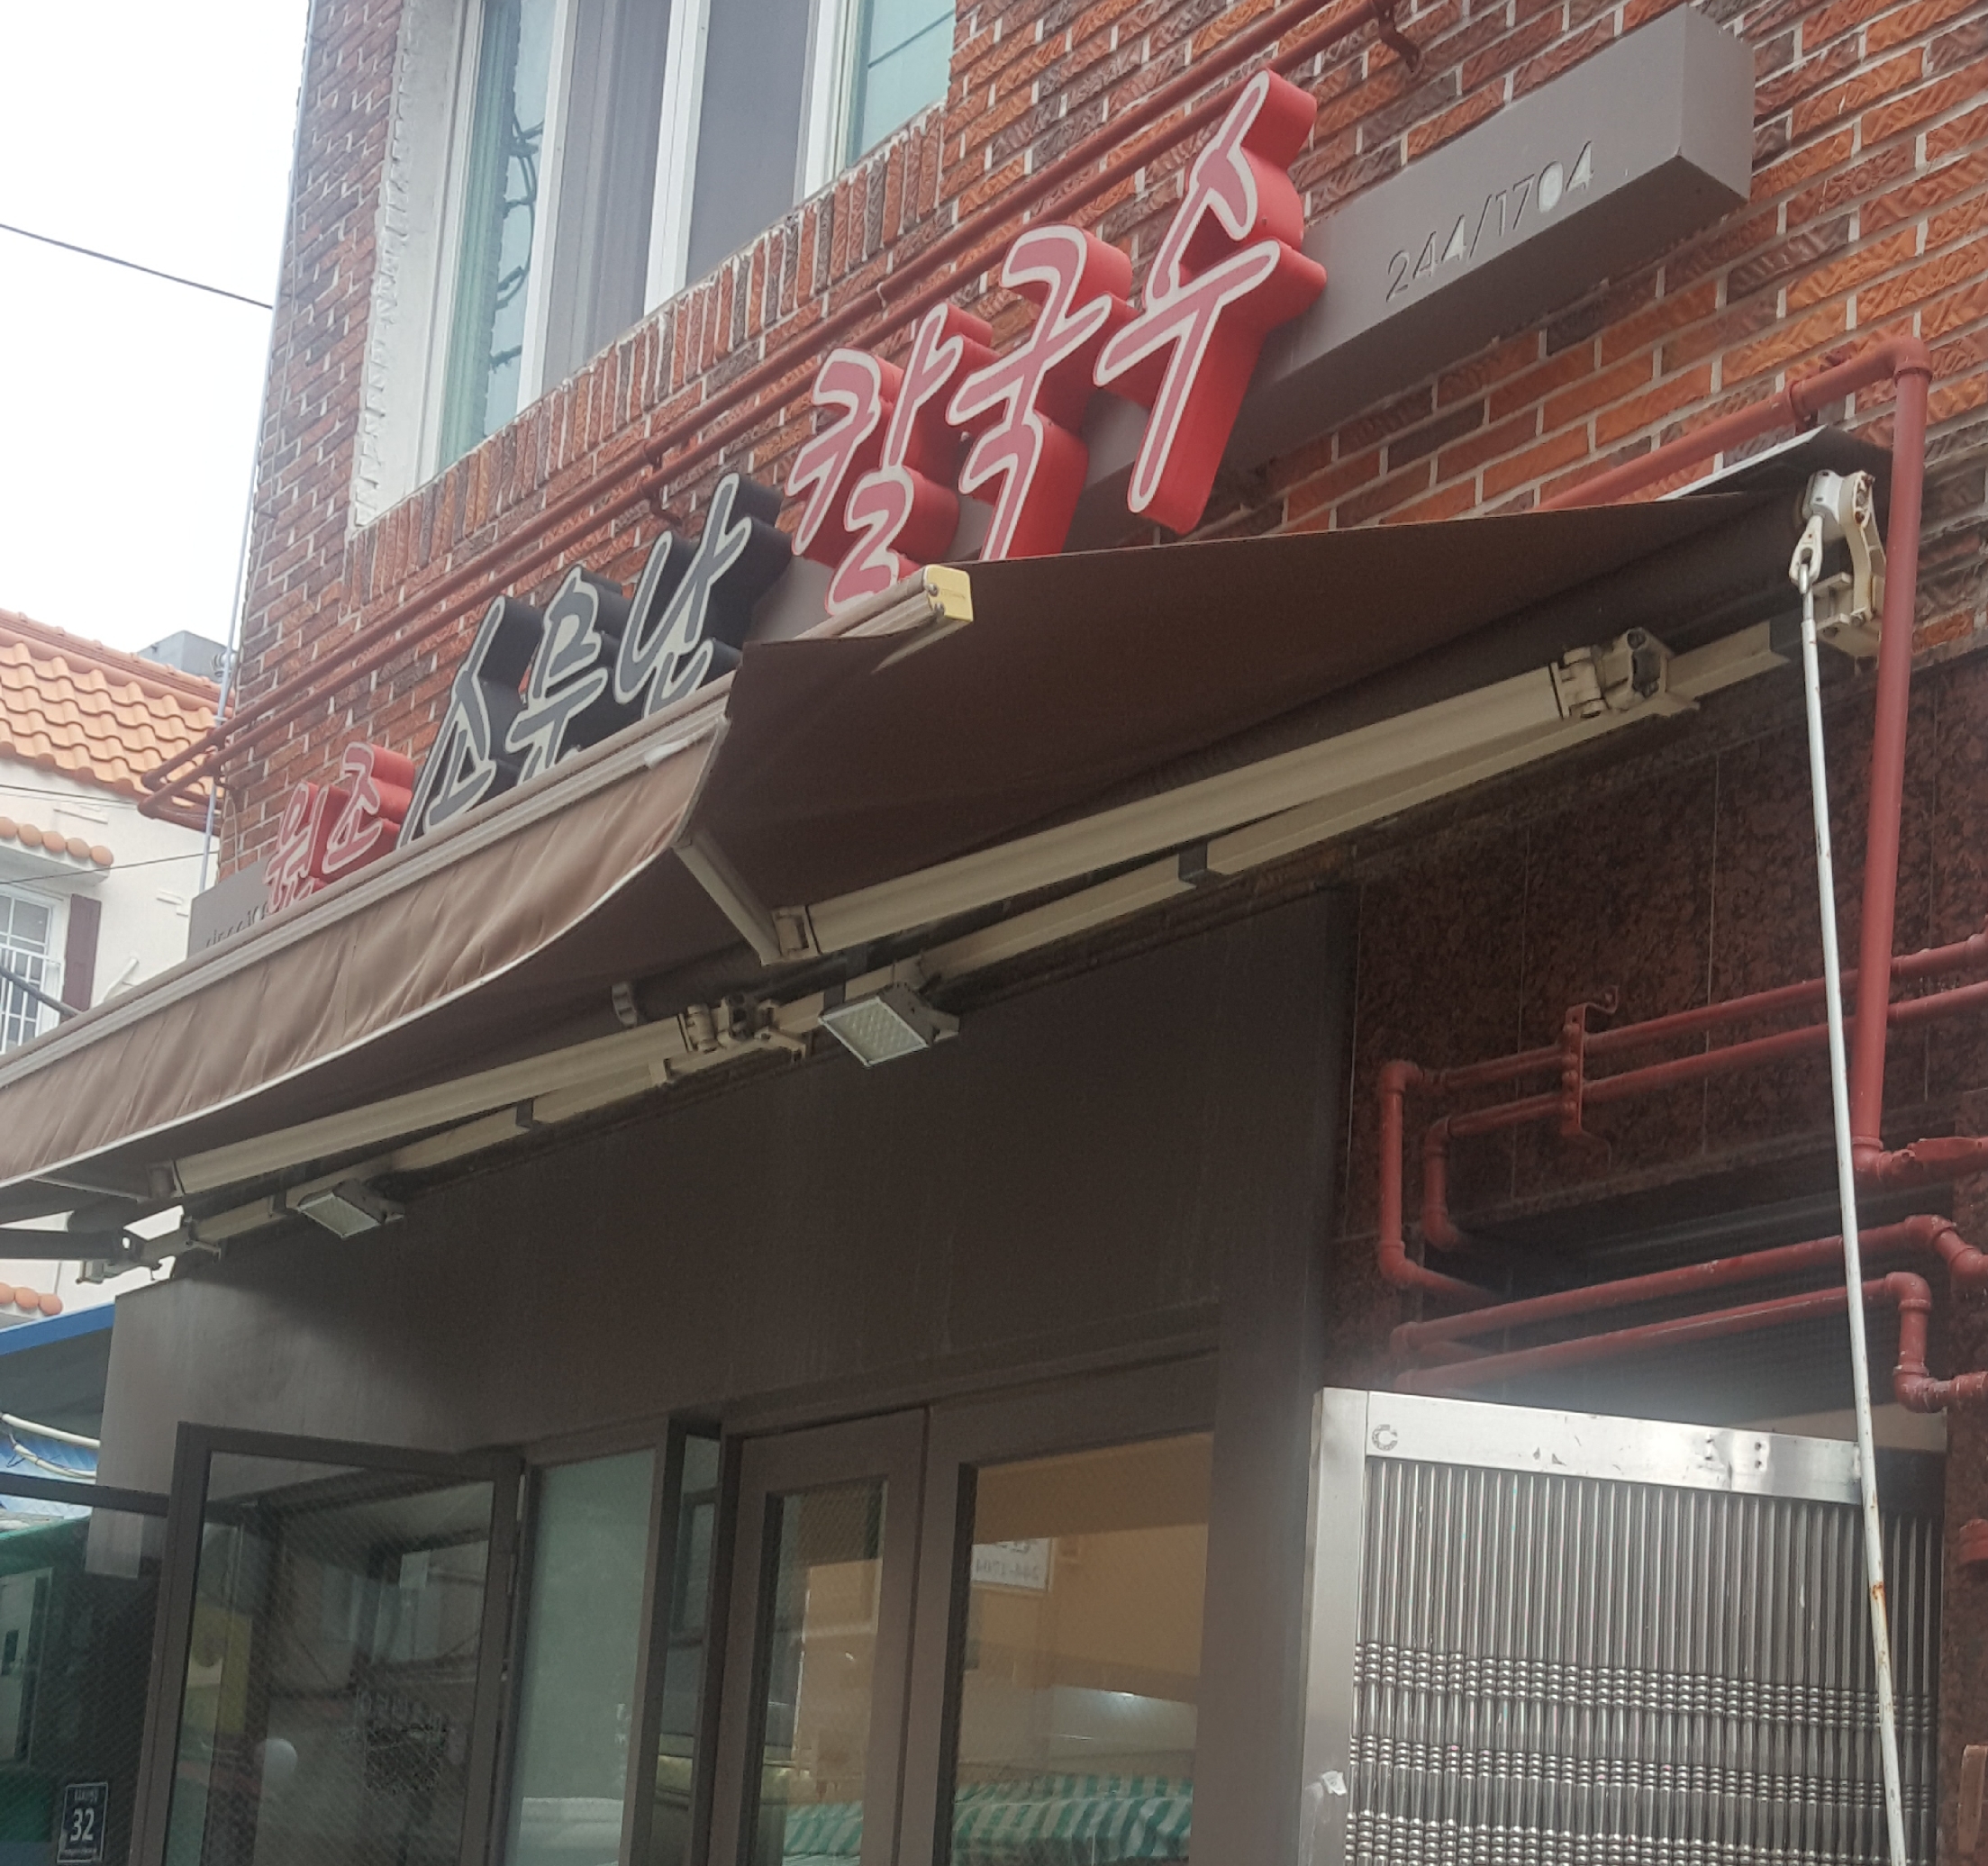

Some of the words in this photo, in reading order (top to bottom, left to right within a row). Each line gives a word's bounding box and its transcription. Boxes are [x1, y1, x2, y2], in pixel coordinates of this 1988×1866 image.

[1384, 140, 1595, 303] 244/1704
[263, 741, 382, 913] 원조
[395, 472, 753, 849] 소문난
[785, 69, 1281, 616] 칼국수
[70, 1807, 95, 1843] 32
